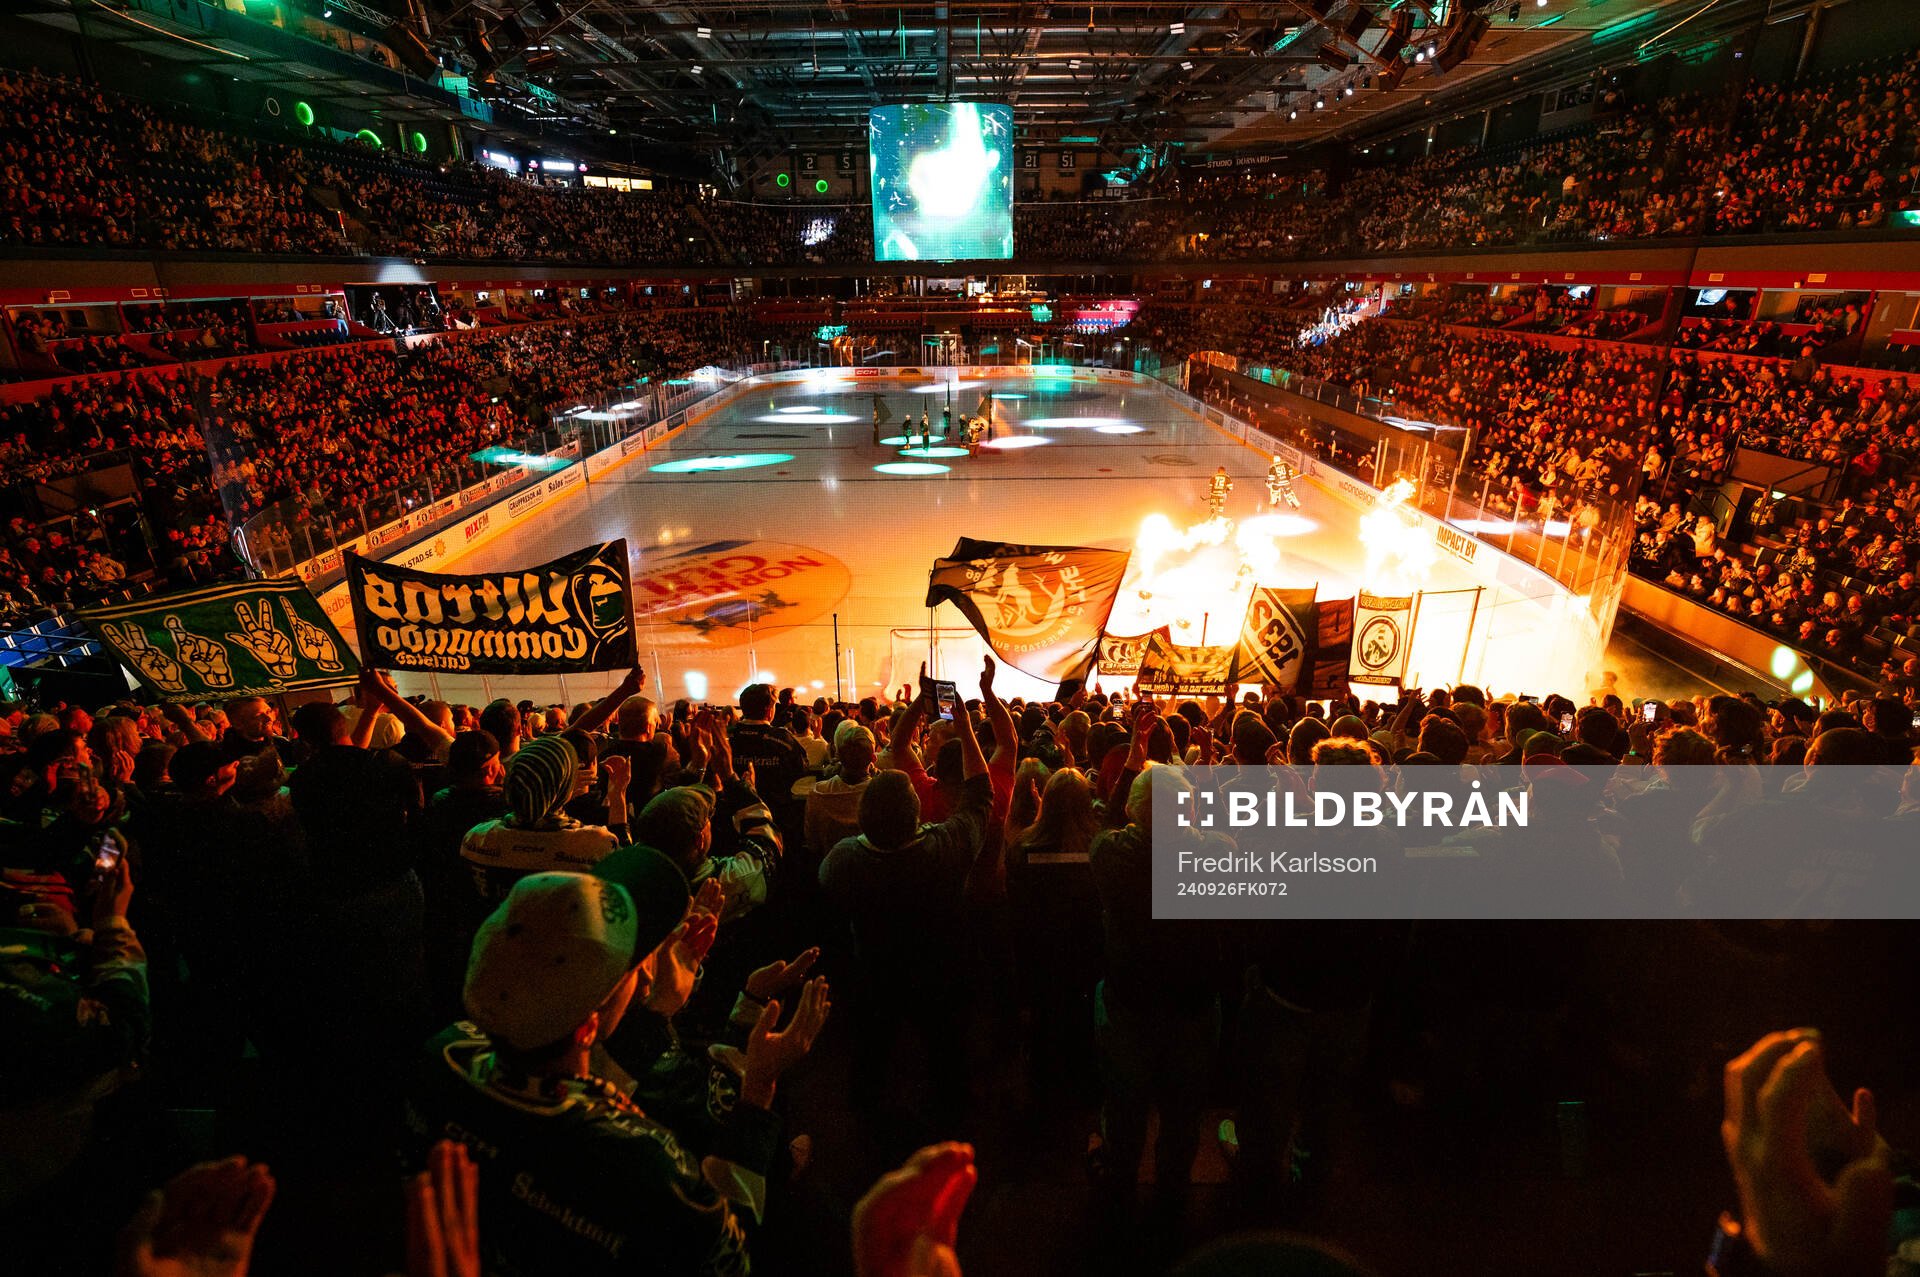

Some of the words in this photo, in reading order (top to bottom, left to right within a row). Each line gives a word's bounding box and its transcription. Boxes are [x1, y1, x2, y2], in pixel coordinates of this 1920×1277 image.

[843, 156, 850, 169] 5
[1025, 154, 1037, 167] 21
[1062, 154, 1074, 167] 51
[1207, 160, 1233, 169] STUDIO
[1276, 466, 1287, 477] 50
[1215, 476, 1226, 487] 72
[465, 512, 489, 539] RIXFM
[1436, 525, 1467, 555] IMPACT
[1465, 539, 1478, 559] BY
